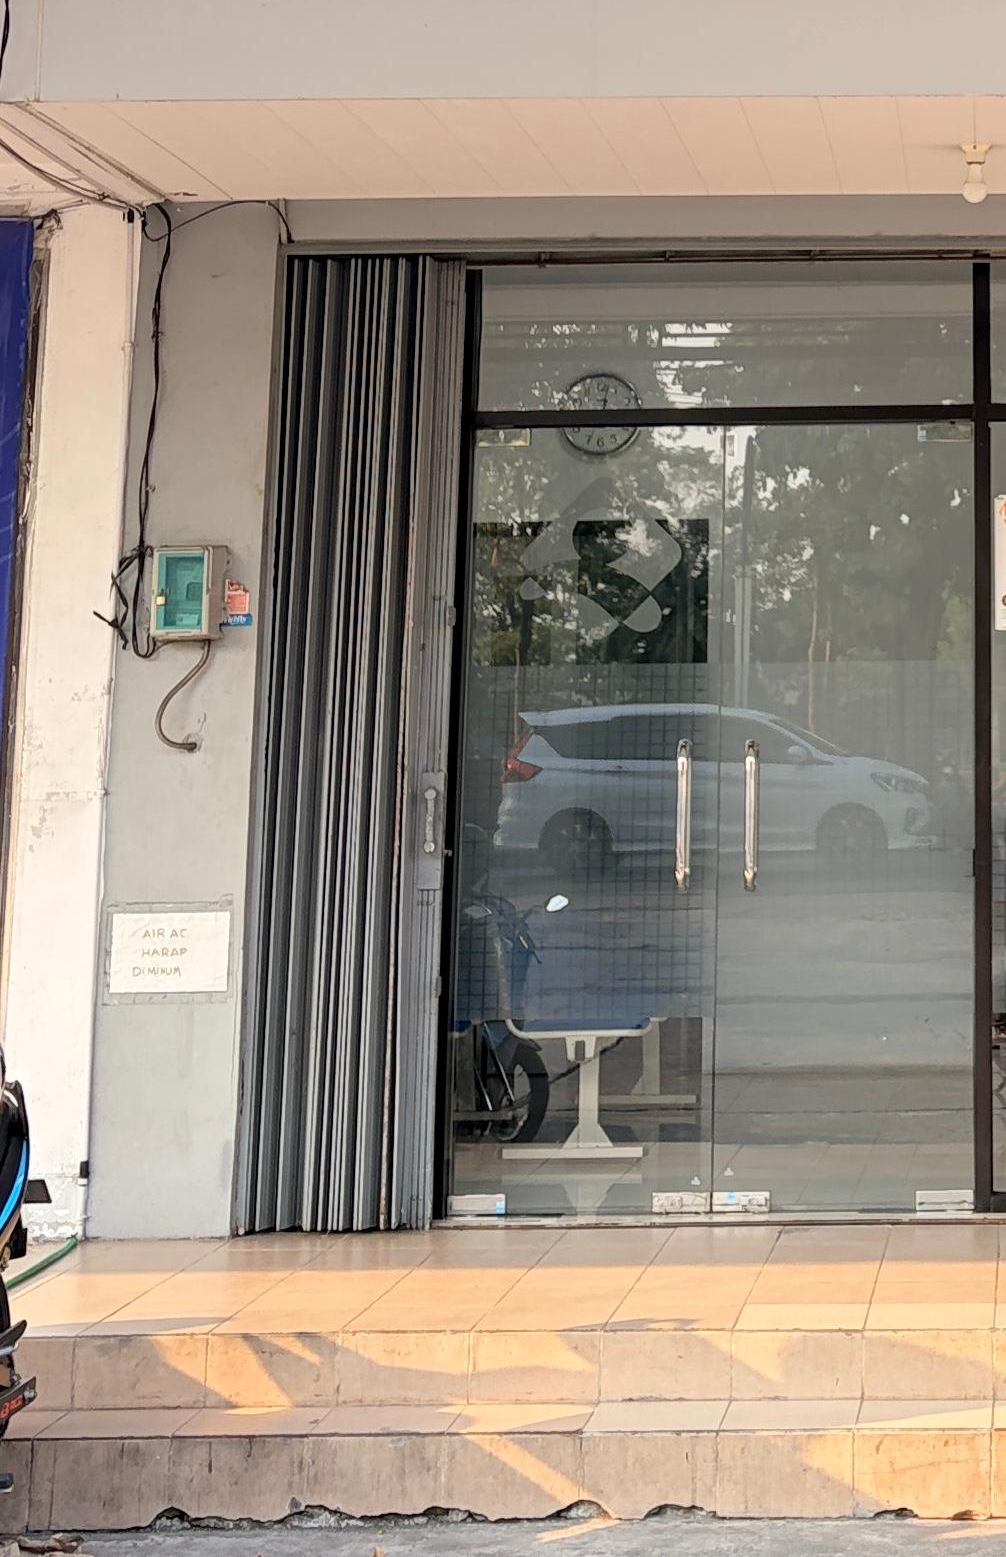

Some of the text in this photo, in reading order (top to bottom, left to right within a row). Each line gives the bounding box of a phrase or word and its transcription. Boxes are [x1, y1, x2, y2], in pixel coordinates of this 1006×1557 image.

[142, 928, 188, 939] AIR AC
[141, 947, 188, 957] HARAP
